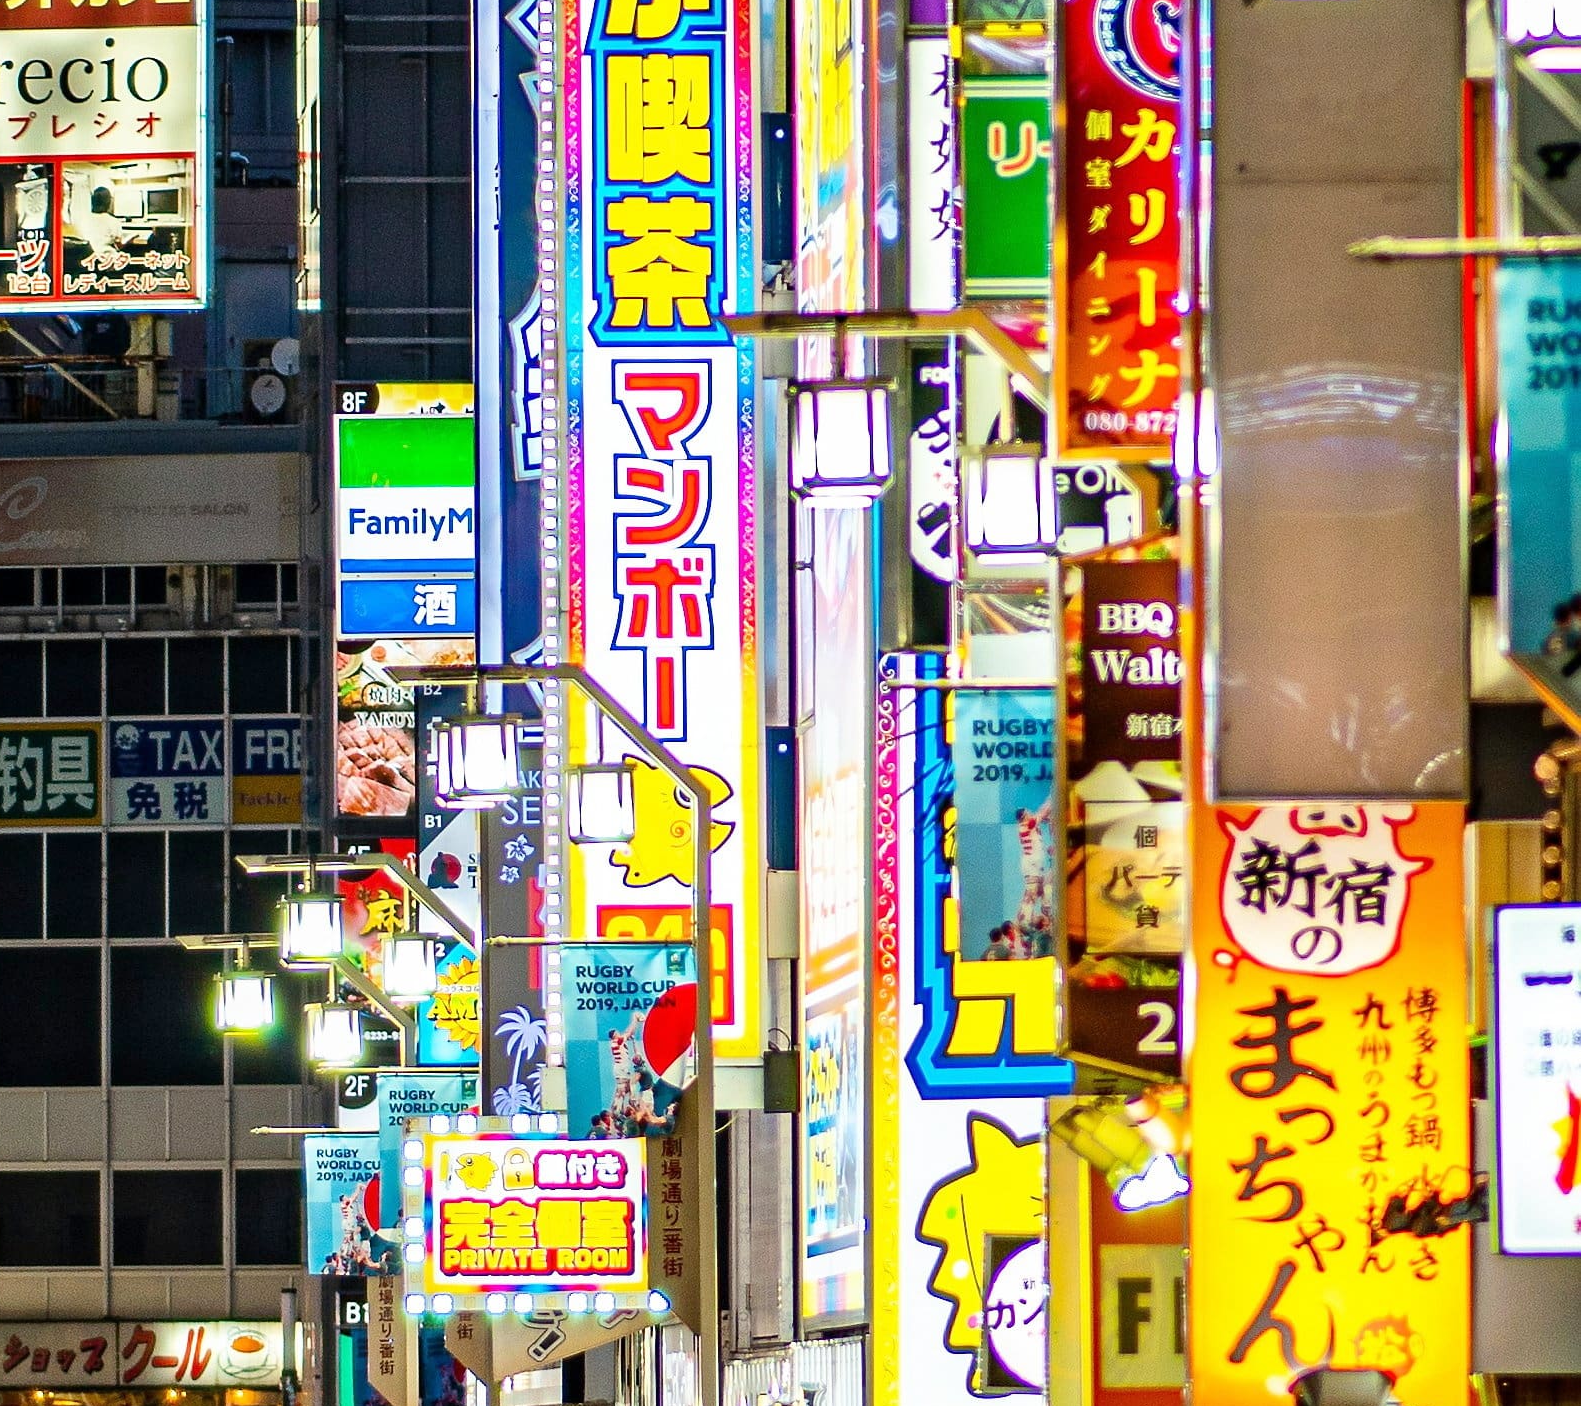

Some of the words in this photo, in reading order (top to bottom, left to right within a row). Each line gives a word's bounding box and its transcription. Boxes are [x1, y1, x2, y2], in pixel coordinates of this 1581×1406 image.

[82, 250, 190, 271] インターネット
[1085, 110, 1115, 401] 個室ダイニング
[1114, 108, 1180, 408] カリーナ
[7, 274, 50, 294] 12台
[64, 272, 190, 294] レディースルーム
[343, 392, 367, 412] 8F
[348, 508, 474, 543] FamilyM
[618, 365, 711, 735] マンボー
[412, 583, 458, 626] 酒
[1098, 602, 1174, 636] BBQ
[423, 683, 442, 696] B2
[972, 719, 1053, 737] RUGBY
[148, 728, 222, 771] TAX
[126, 780, 208, 820] 免税
[424, 814, 442, 828] B1
[576, 965, 634, 979] RUGBY
[576, 980, 637, 995] WORLD
[640, 980, 676, 995] CUP
[576, 997, 618, 1012] 2019,
[620, 997, 676, 1011] JAPAN
[1402, 986, 1444, 1152] 博多もつ鍋
[345, 1075, 369, 1097] 2F
[389, 1090, 436, 1101] RUGBY
[389, 1102, 438, 1114] WORLD
[440, 1102, 468, 1114] CUP
[317, 1149, 359, 1159] RUGBY
[317, 1160, 361, 1170] WORLD
[363, 1160, 381, 1170] CU
[317, 1171, 347, 1183] 2019,
[1228, 985, 1347, 1367] まっちゃん
[661, 1137, 684, 1278] 劇場通り一番街
[444, 1199, 629, 1249] 完全個室
[444, 1248, 547, 1270] PRIVATE
[557, 1248, 628, 1269] ROOM
[122, 1326, 212, 1383] クール
